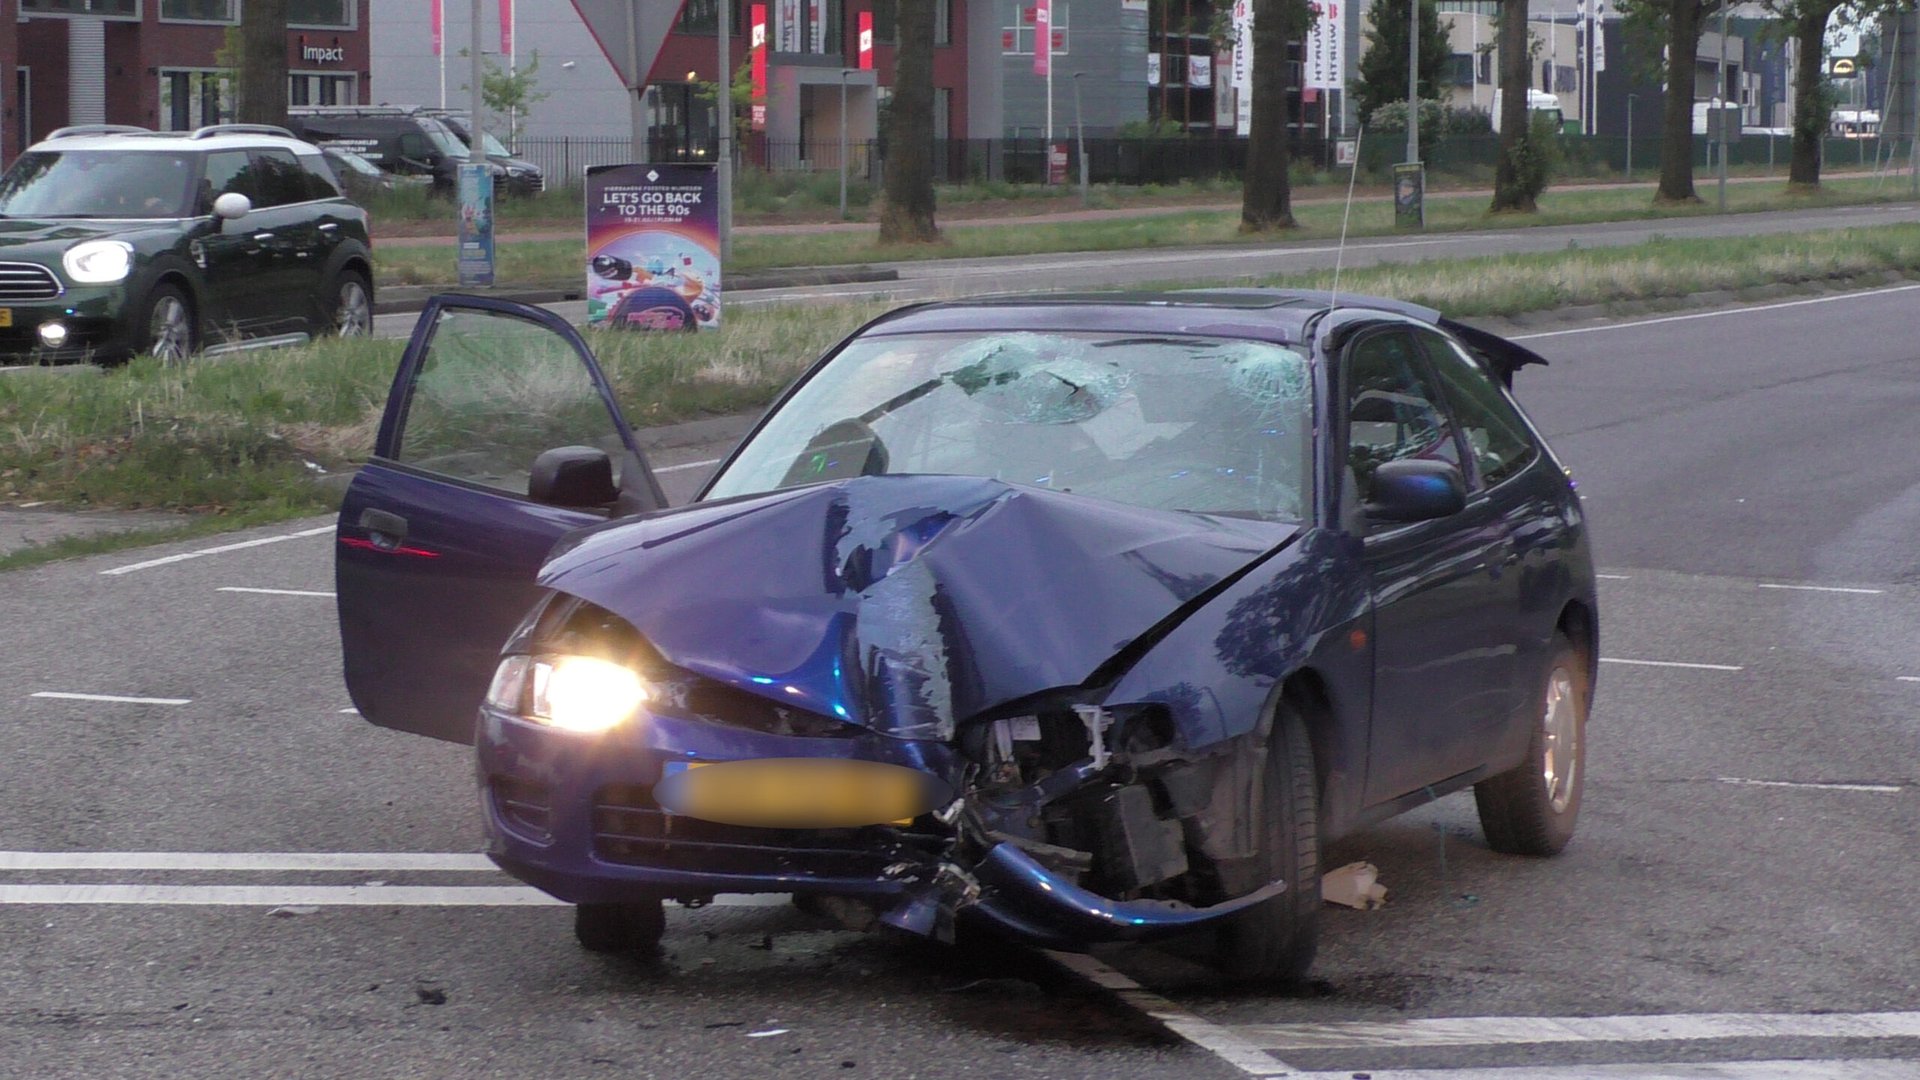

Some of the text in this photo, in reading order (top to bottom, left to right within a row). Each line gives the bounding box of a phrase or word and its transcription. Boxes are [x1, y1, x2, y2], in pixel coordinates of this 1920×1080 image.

[603, 192, 702, 204] LET'S GO BACK
[618, 204, 691, 215] TO THE 90s
